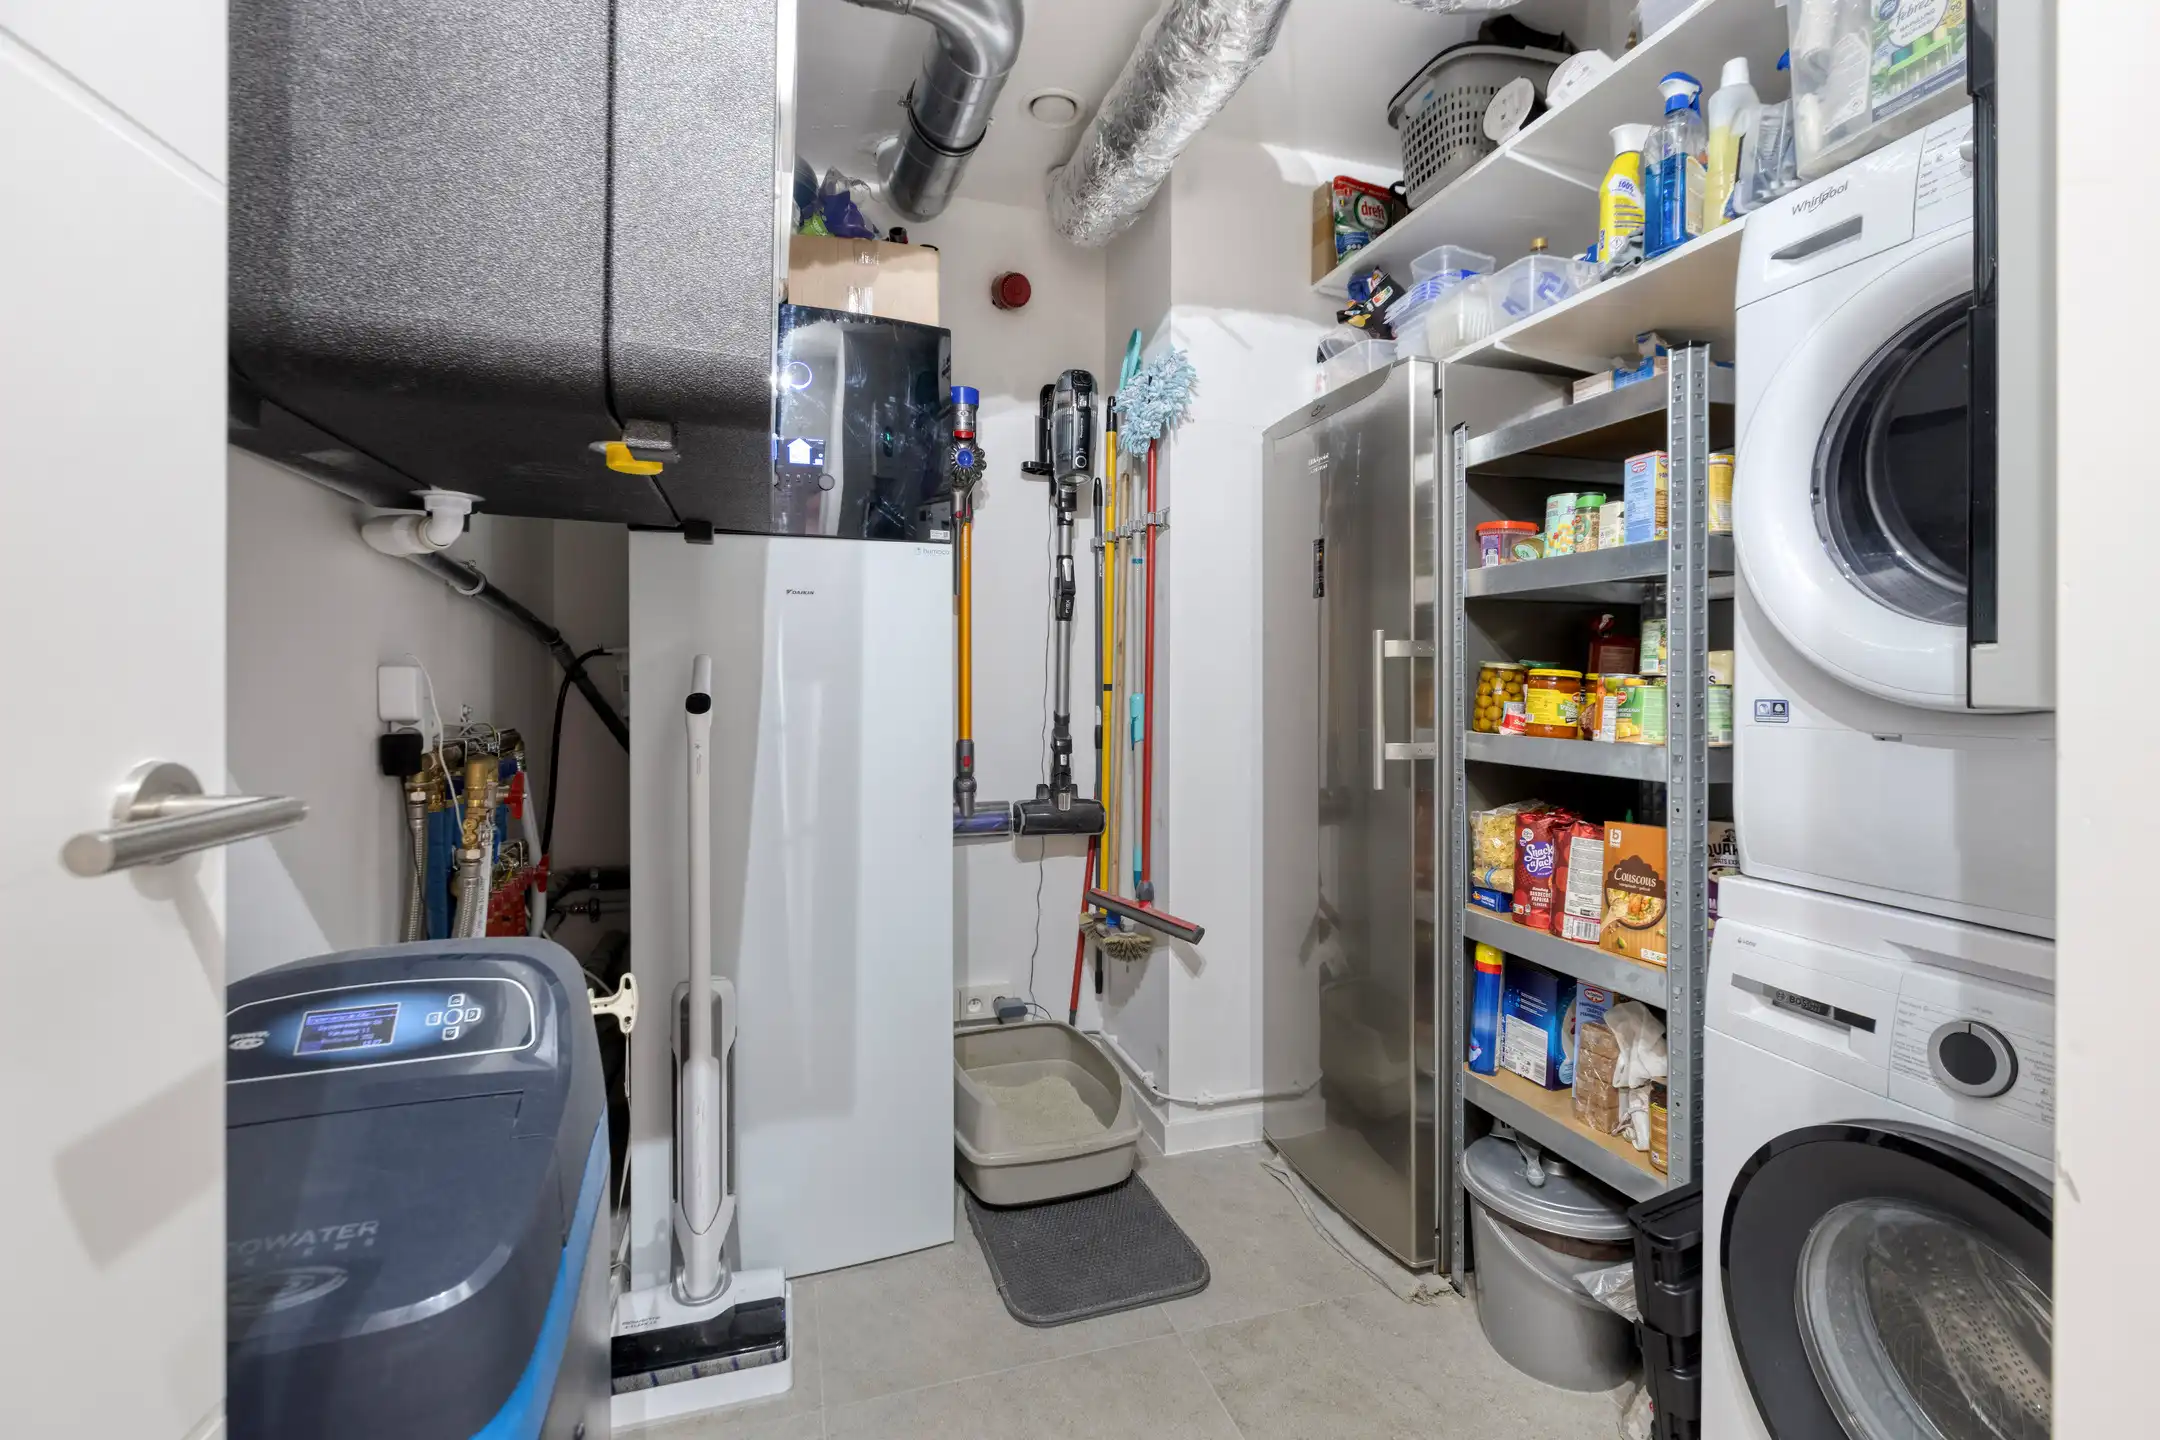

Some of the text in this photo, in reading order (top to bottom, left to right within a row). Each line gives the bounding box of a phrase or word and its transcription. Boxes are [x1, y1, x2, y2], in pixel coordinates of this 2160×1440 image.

[1896, 0, 1934, 27] febrez
[1791, 180, 1849, 216] Whirlpool
[1361, 200, 1385, 219] dreft
[1523, 843, 1554, 861] Snack
[1708, 843, 1739, 857] QUAK
[1614, 867, 1657, 887] Couscous
[1789, 995, 1821, 1013] BOSCH
